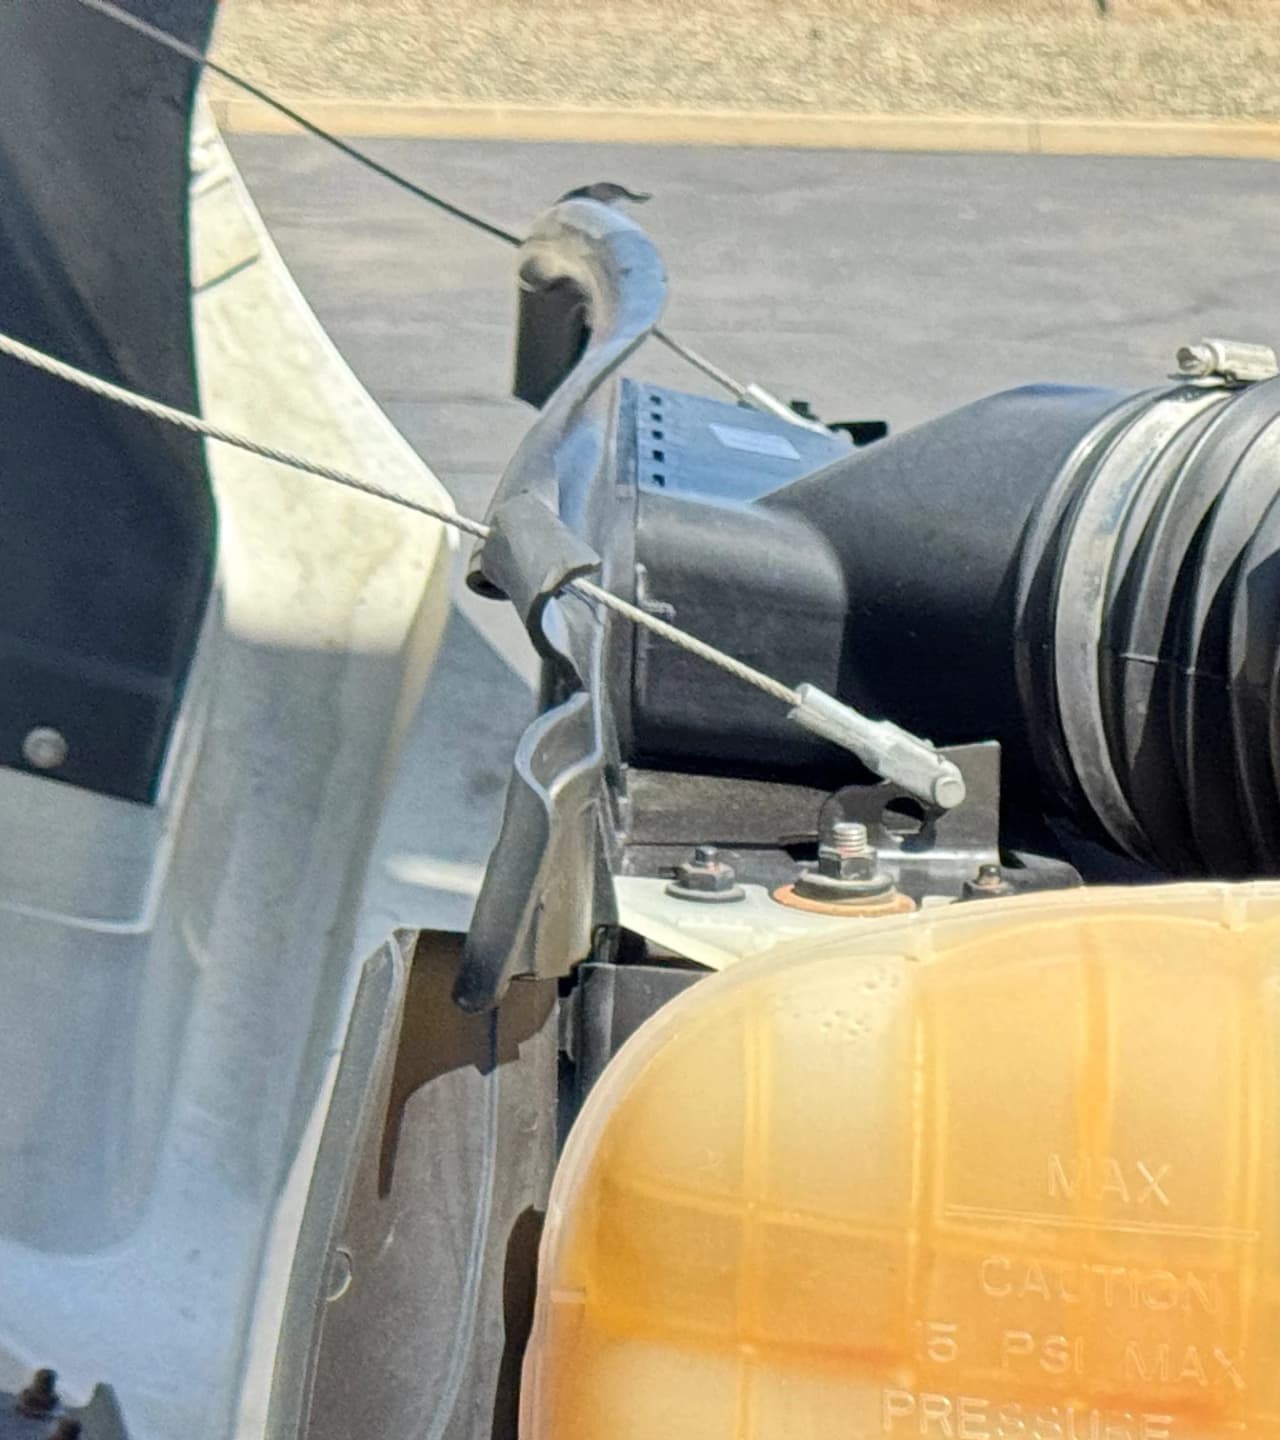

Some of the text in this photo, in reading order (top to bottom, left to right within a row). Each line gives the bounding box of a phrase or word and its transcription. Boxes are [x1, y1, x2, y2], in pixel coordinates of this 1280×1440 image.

[1047, 1153, 1172, 1206] MAX
[980, 1256, 1220, 1314] CAUTION
[1001, 1329, 1084, 1376] PSI
[1123, 1340, 1247, 1389] MAX
